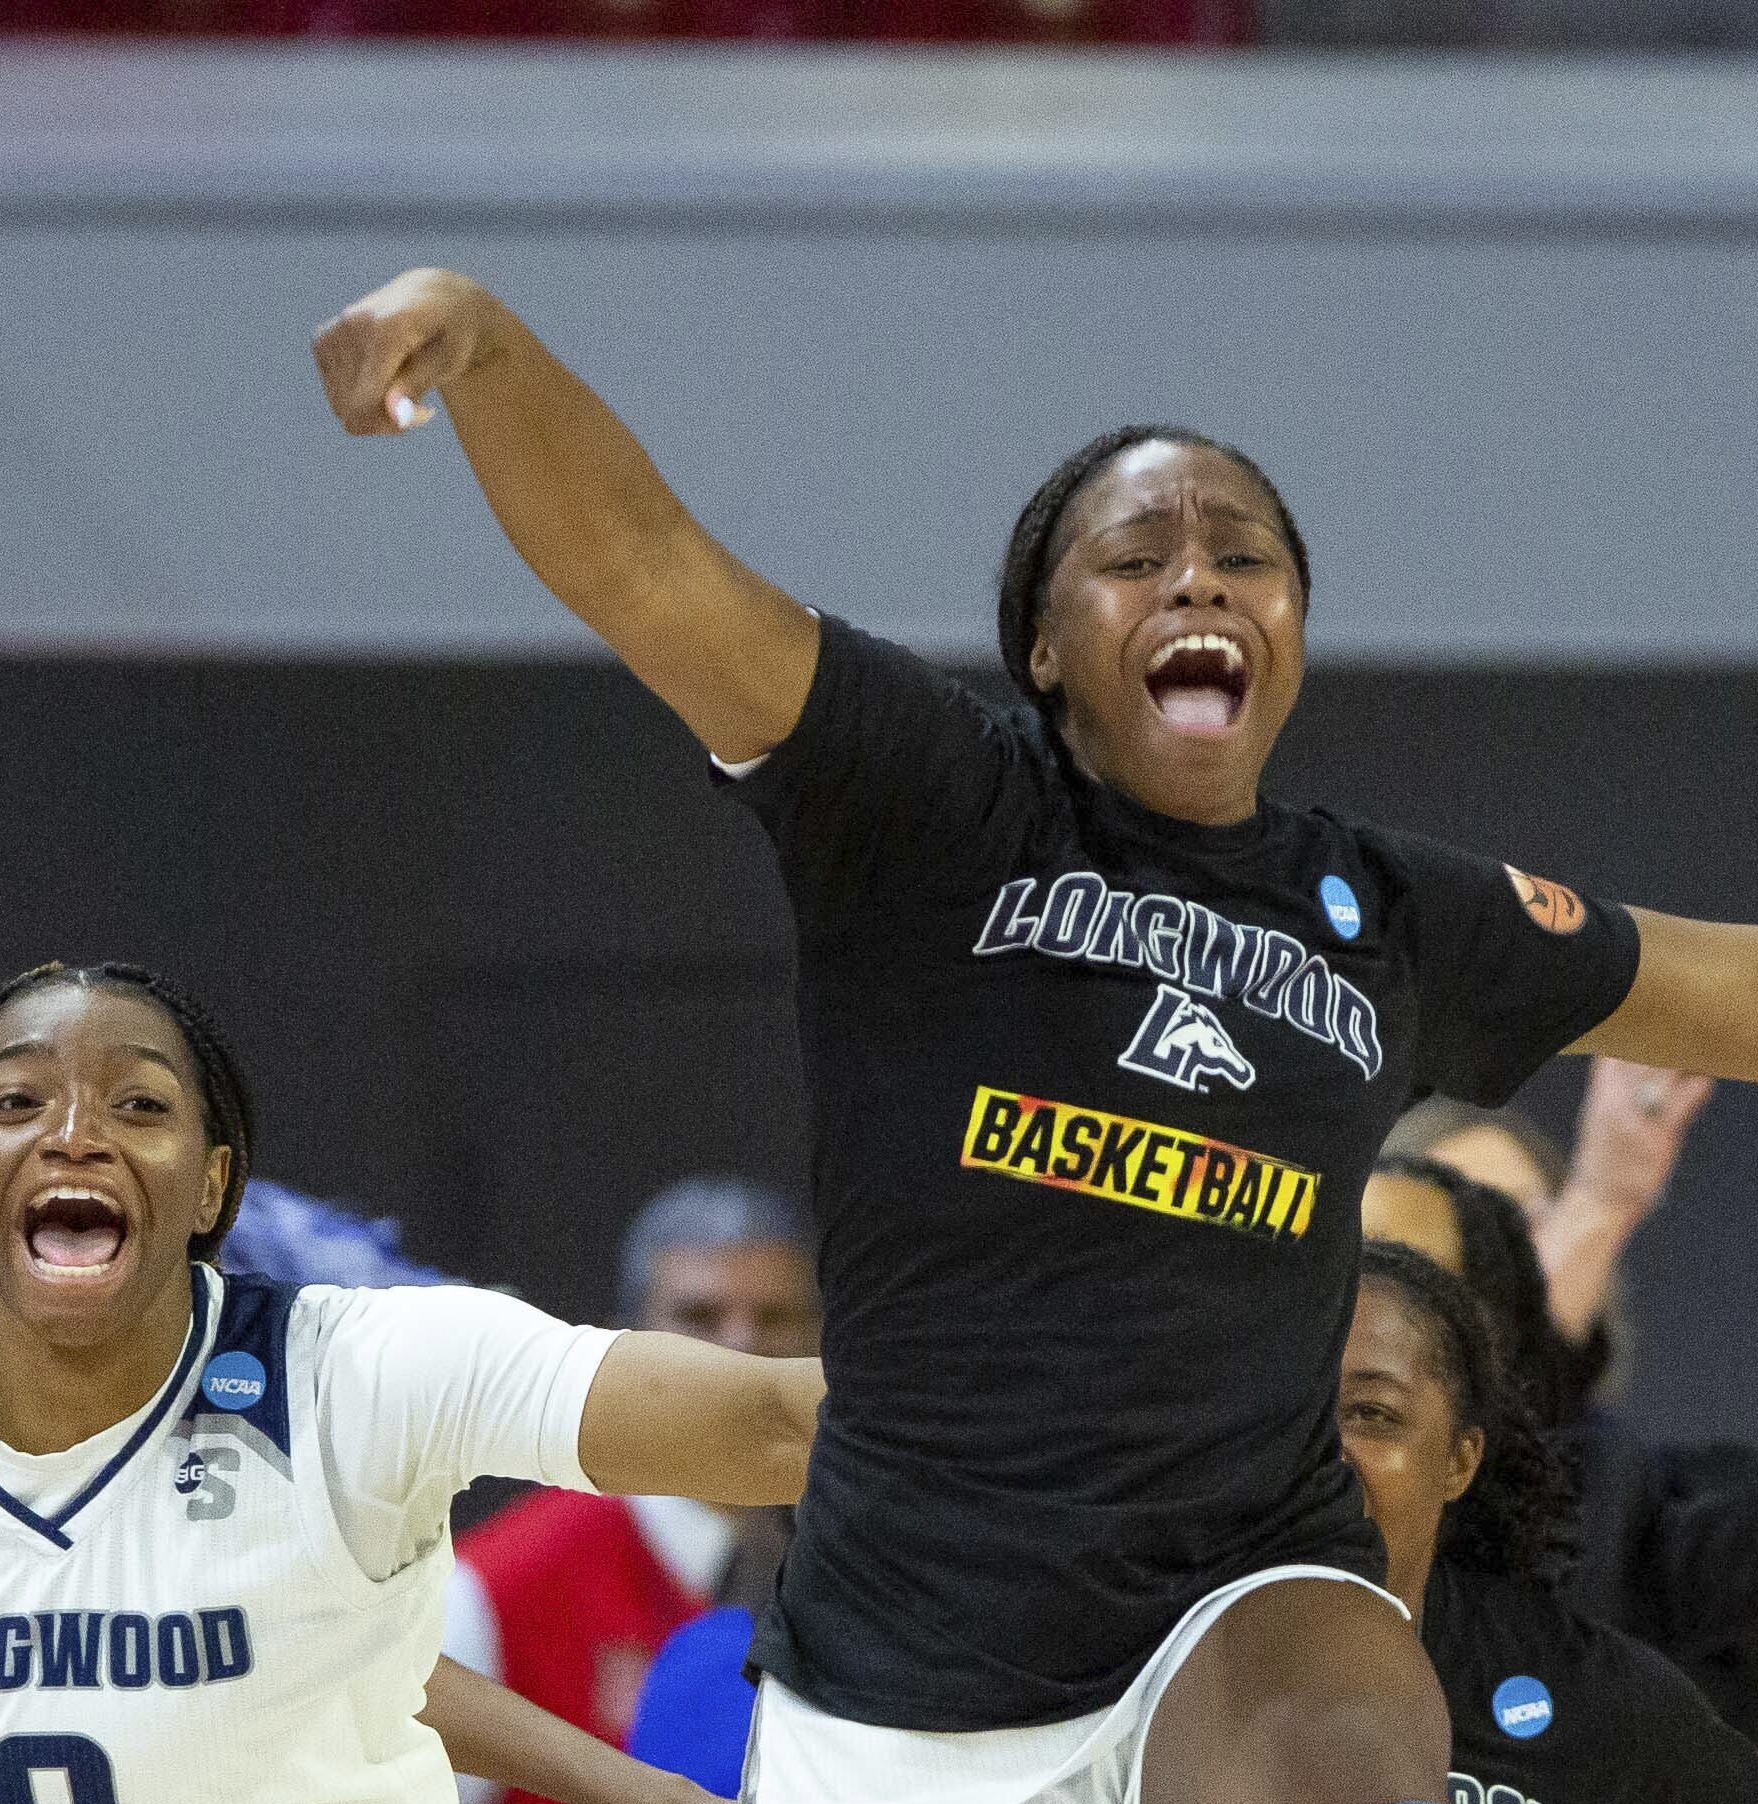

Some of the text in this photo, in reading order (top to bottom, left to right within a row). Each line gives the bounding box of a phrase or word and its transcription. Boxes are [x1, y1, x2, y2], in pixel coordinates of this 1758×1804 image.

[973, 871, 1382, 1082] LONGWOOD
[968, 1091, 1312, 1236] BASKETBALL
[210, 1377, 261, 1395] NCAA
